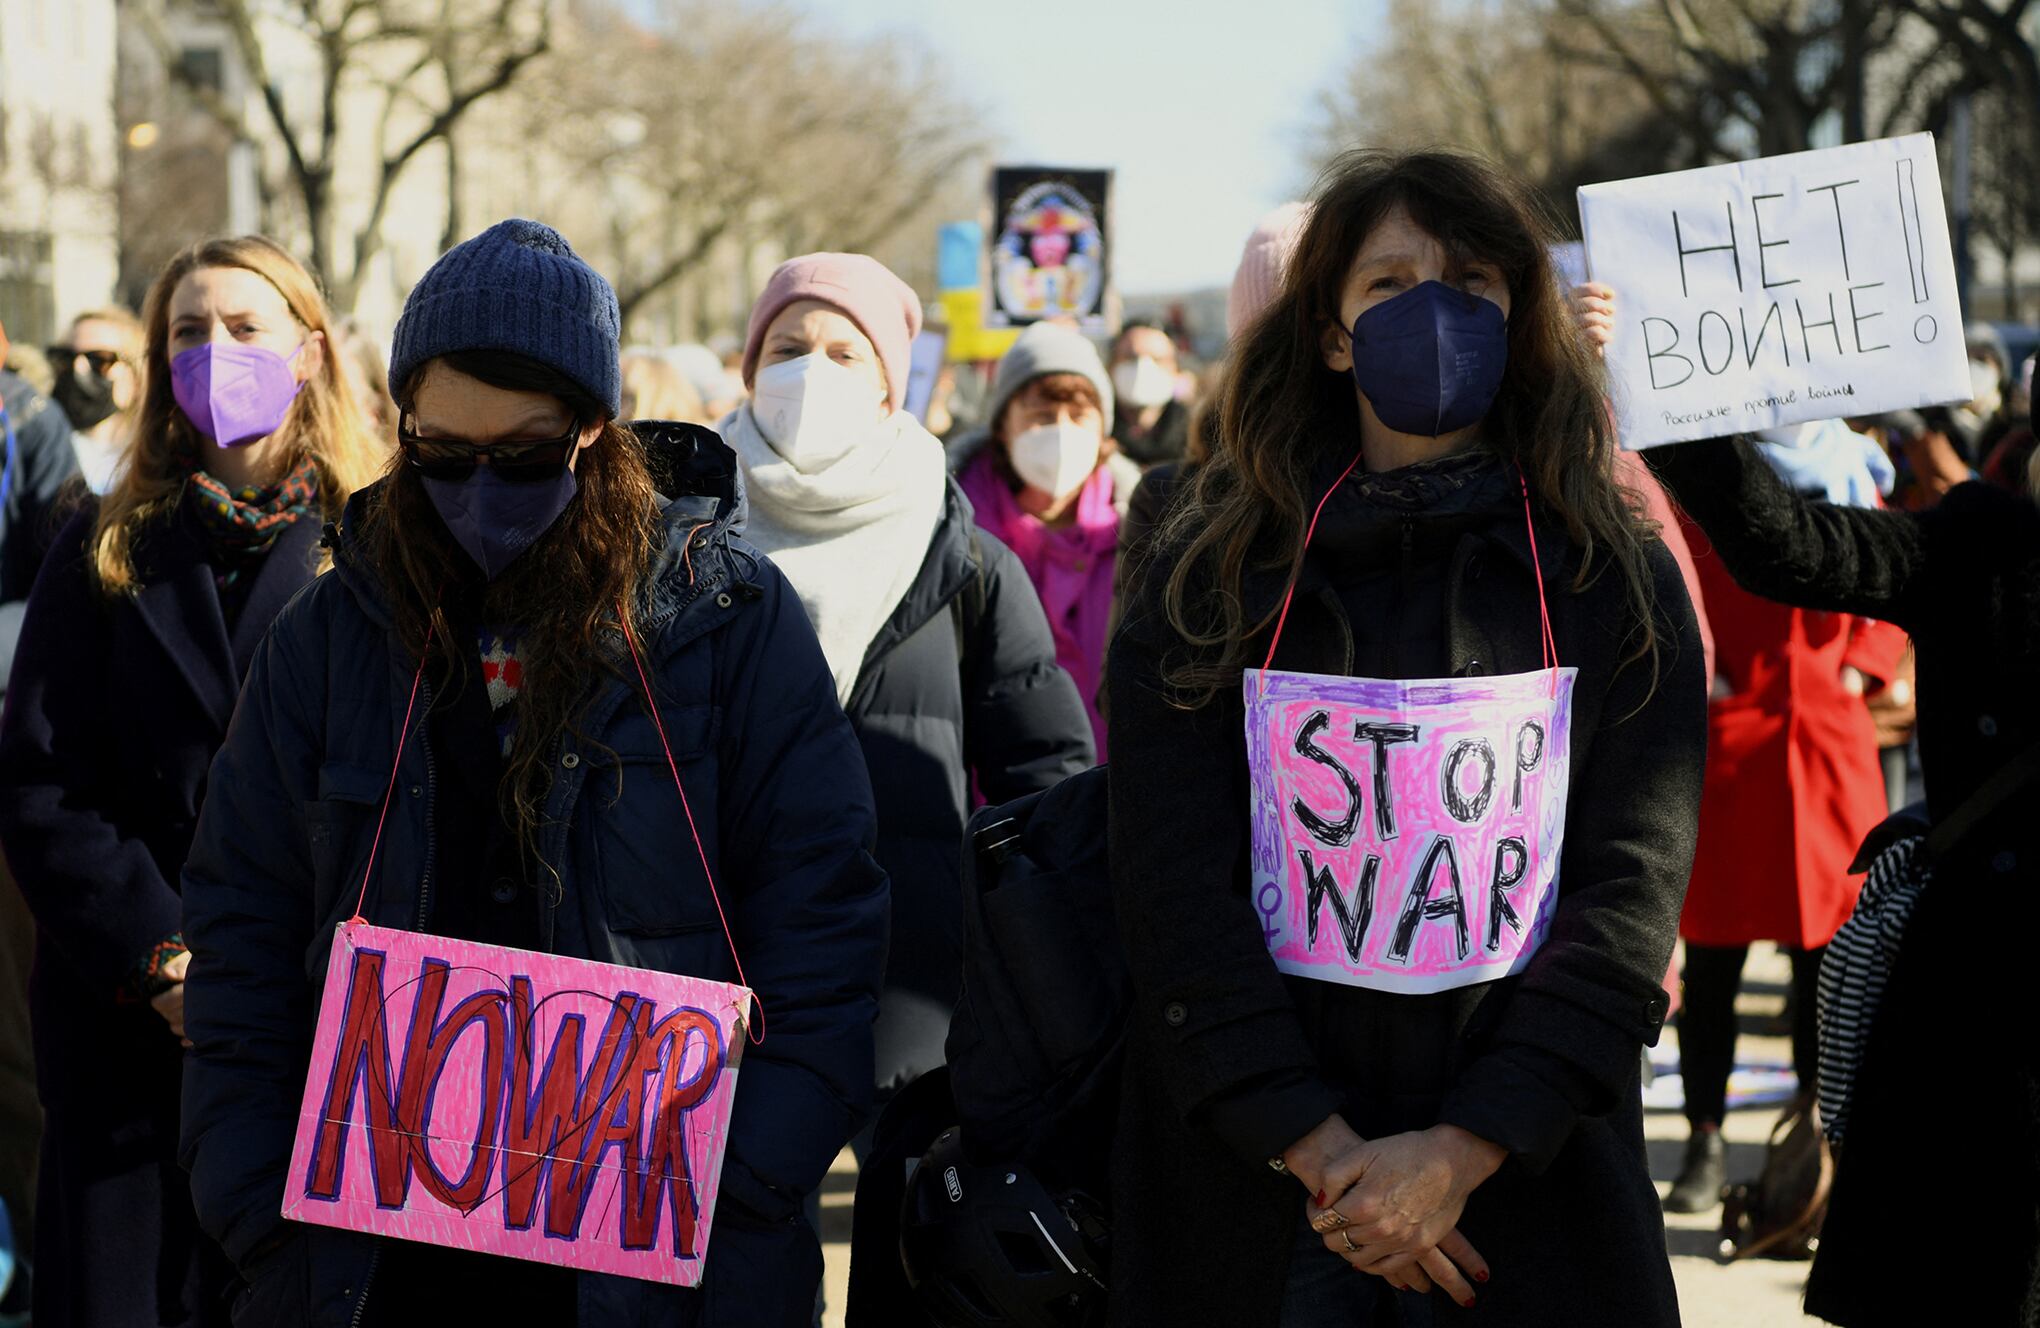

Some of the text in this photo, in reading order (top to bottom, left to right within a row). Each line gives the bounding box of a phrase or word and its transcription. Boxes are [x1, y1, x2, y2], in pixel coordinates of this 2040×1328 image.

[1672, 179, 1860, 298] НЕТ
[1744, 390, 1797, 413] против
[1289, 709, 1545, 848] STOP
[1297, 833, 1529, 965] WAR
[946, 1170, 960, 1197] ABUS
